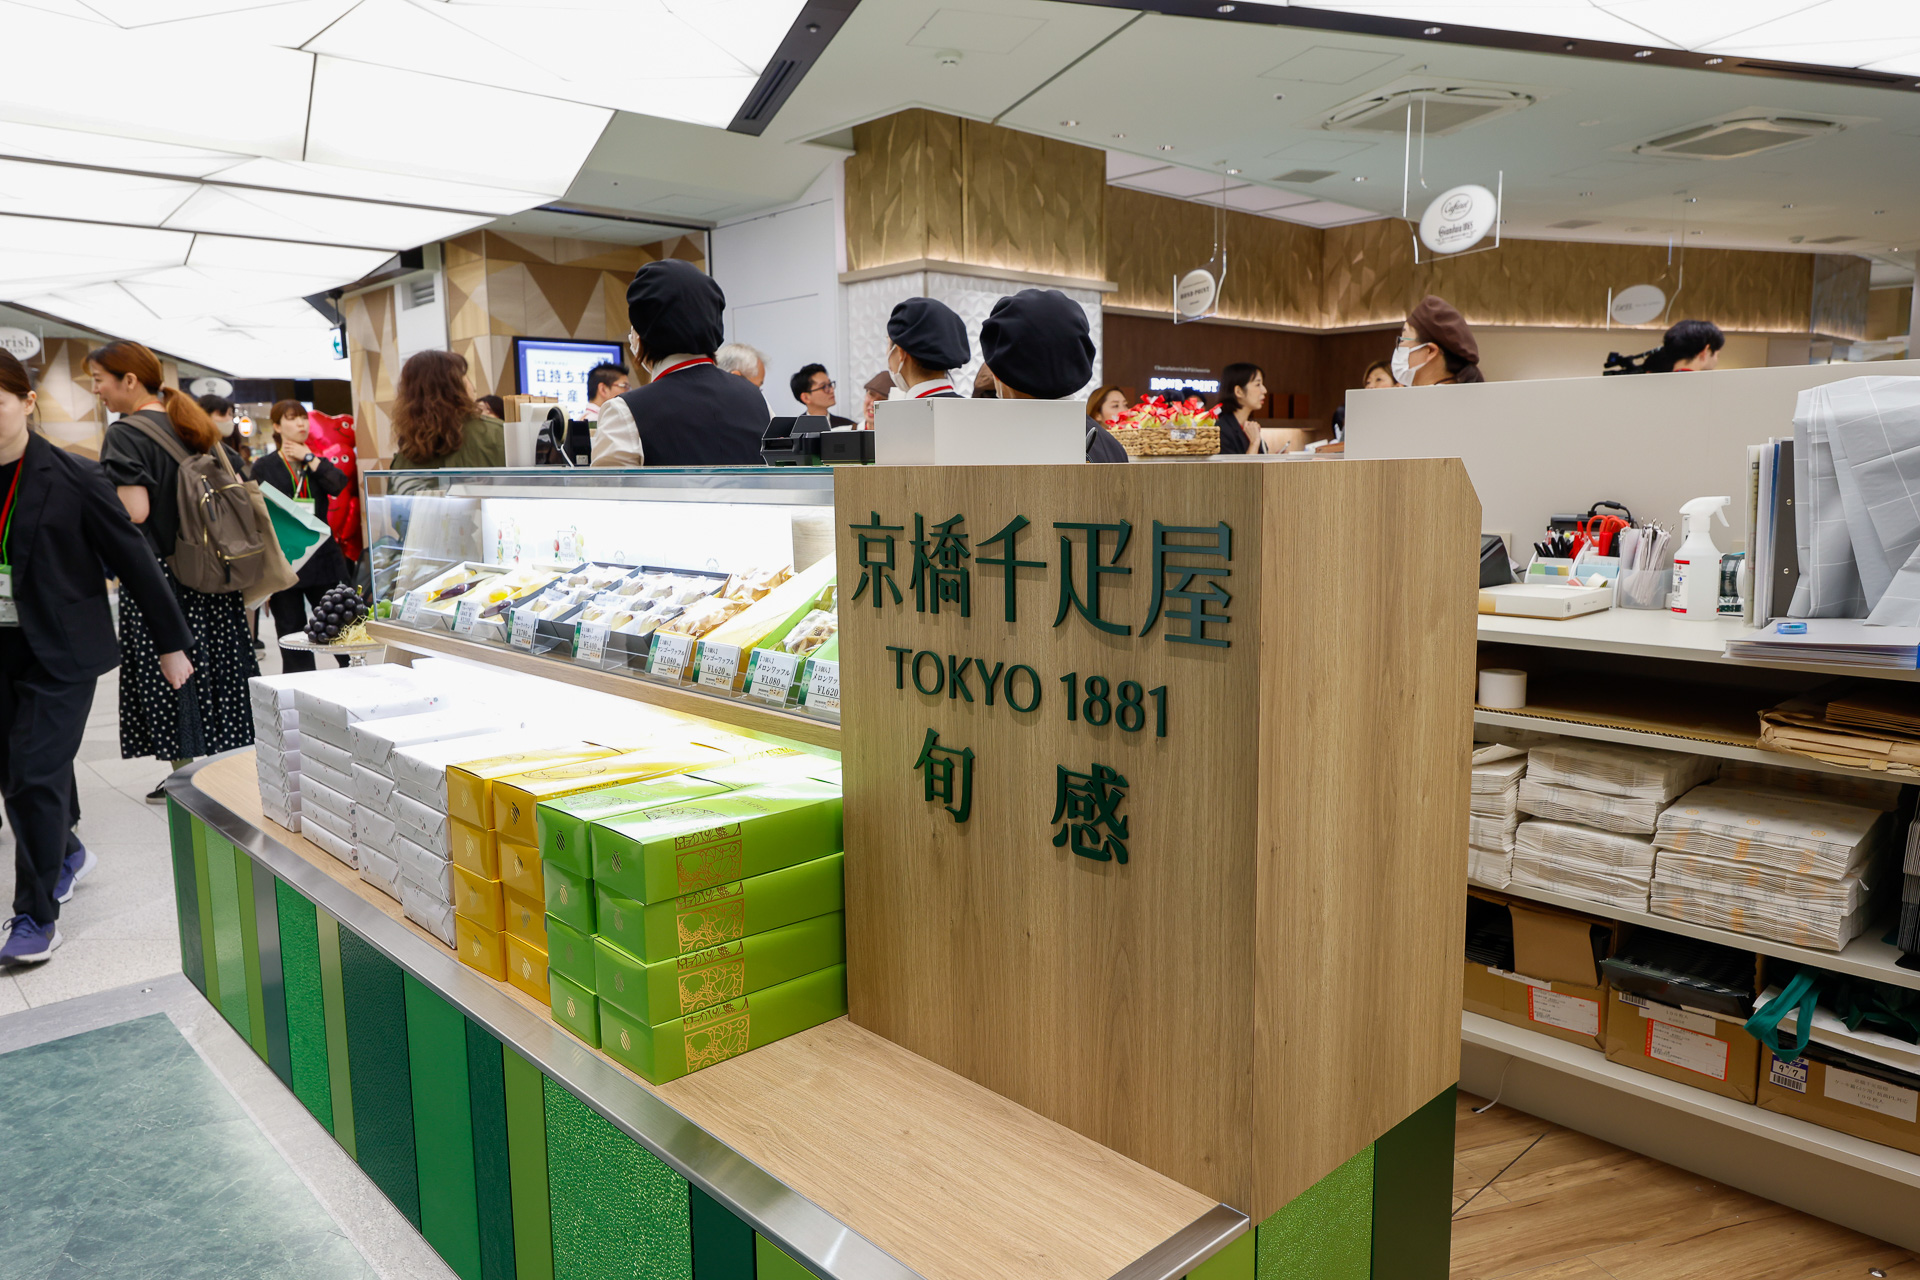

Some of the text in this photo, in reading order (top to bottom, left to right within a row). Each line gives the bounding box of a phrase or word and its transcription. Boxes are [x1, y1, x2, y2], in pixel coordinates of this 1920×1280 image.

[849, 510, 1232, 648] 京橋千疋屋
[886, 645, 1168, 738] TOKYO 1881
[913, 727, 1129, 865] 旬 感
